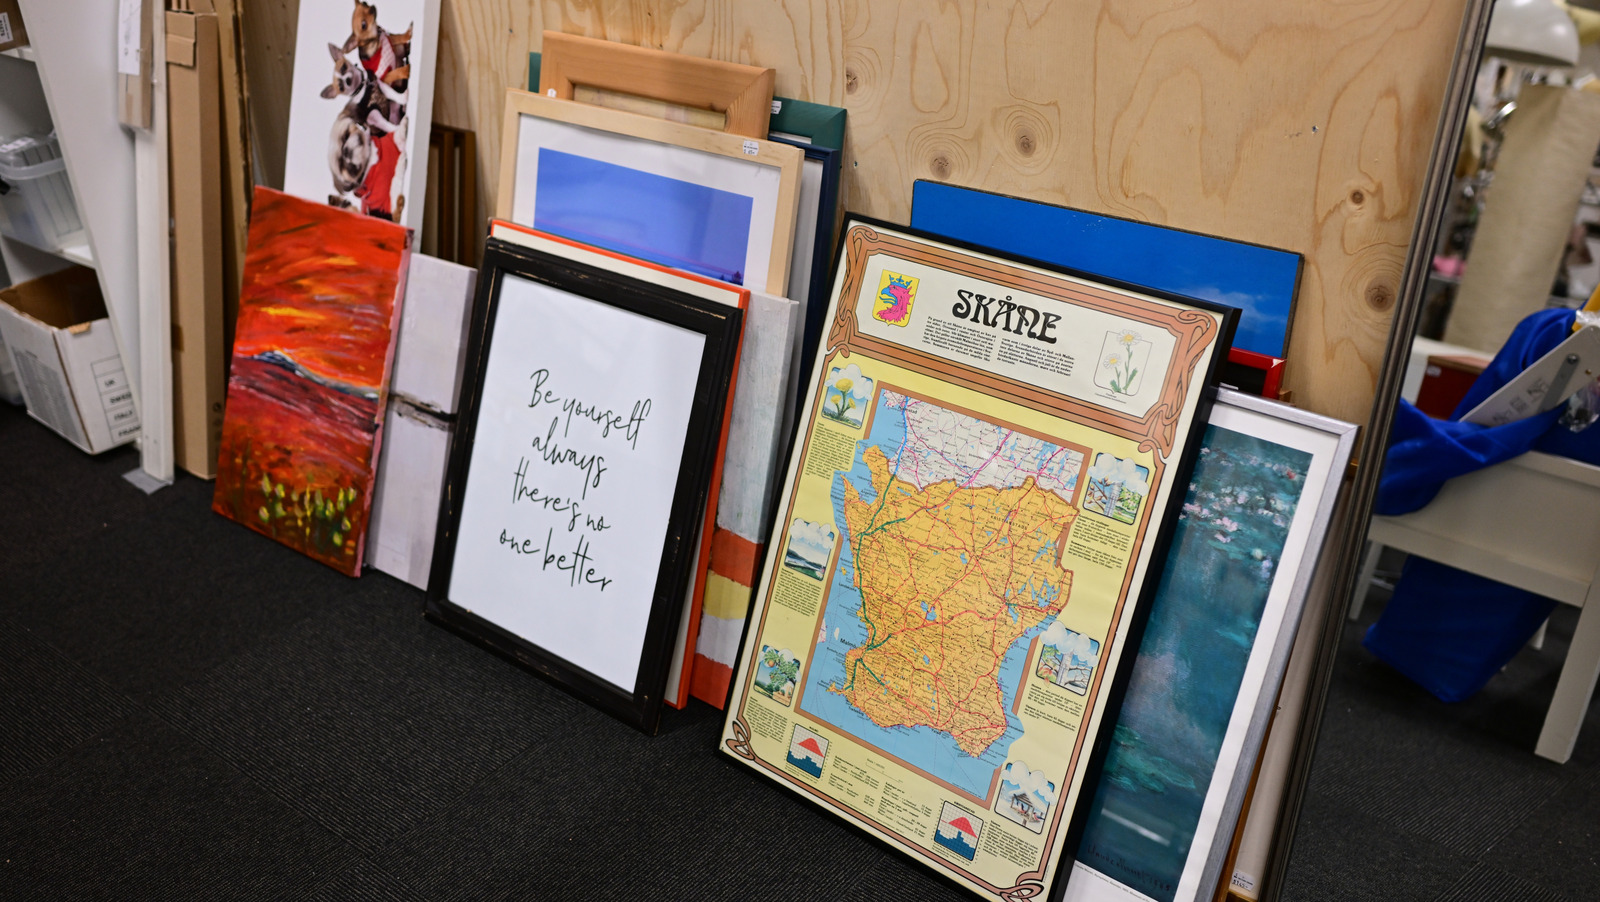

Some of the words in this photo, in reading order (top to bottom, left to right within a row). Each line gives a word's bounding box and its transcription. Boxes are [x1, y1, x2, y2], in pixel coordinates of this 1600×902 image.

[952, 289, 1062, 344] SKÅNE
[528, 369, 560, 408] Be
[563, 398, 652, 450] yourself
[532, 417, 607, 500] always
[513, 457, 581, 531] there's
[587, 513, 611, 531] no
[500, 529, 540, 554] one
[543, 528, 612, 591] better
[839, 638, 858, 649] Malmö
